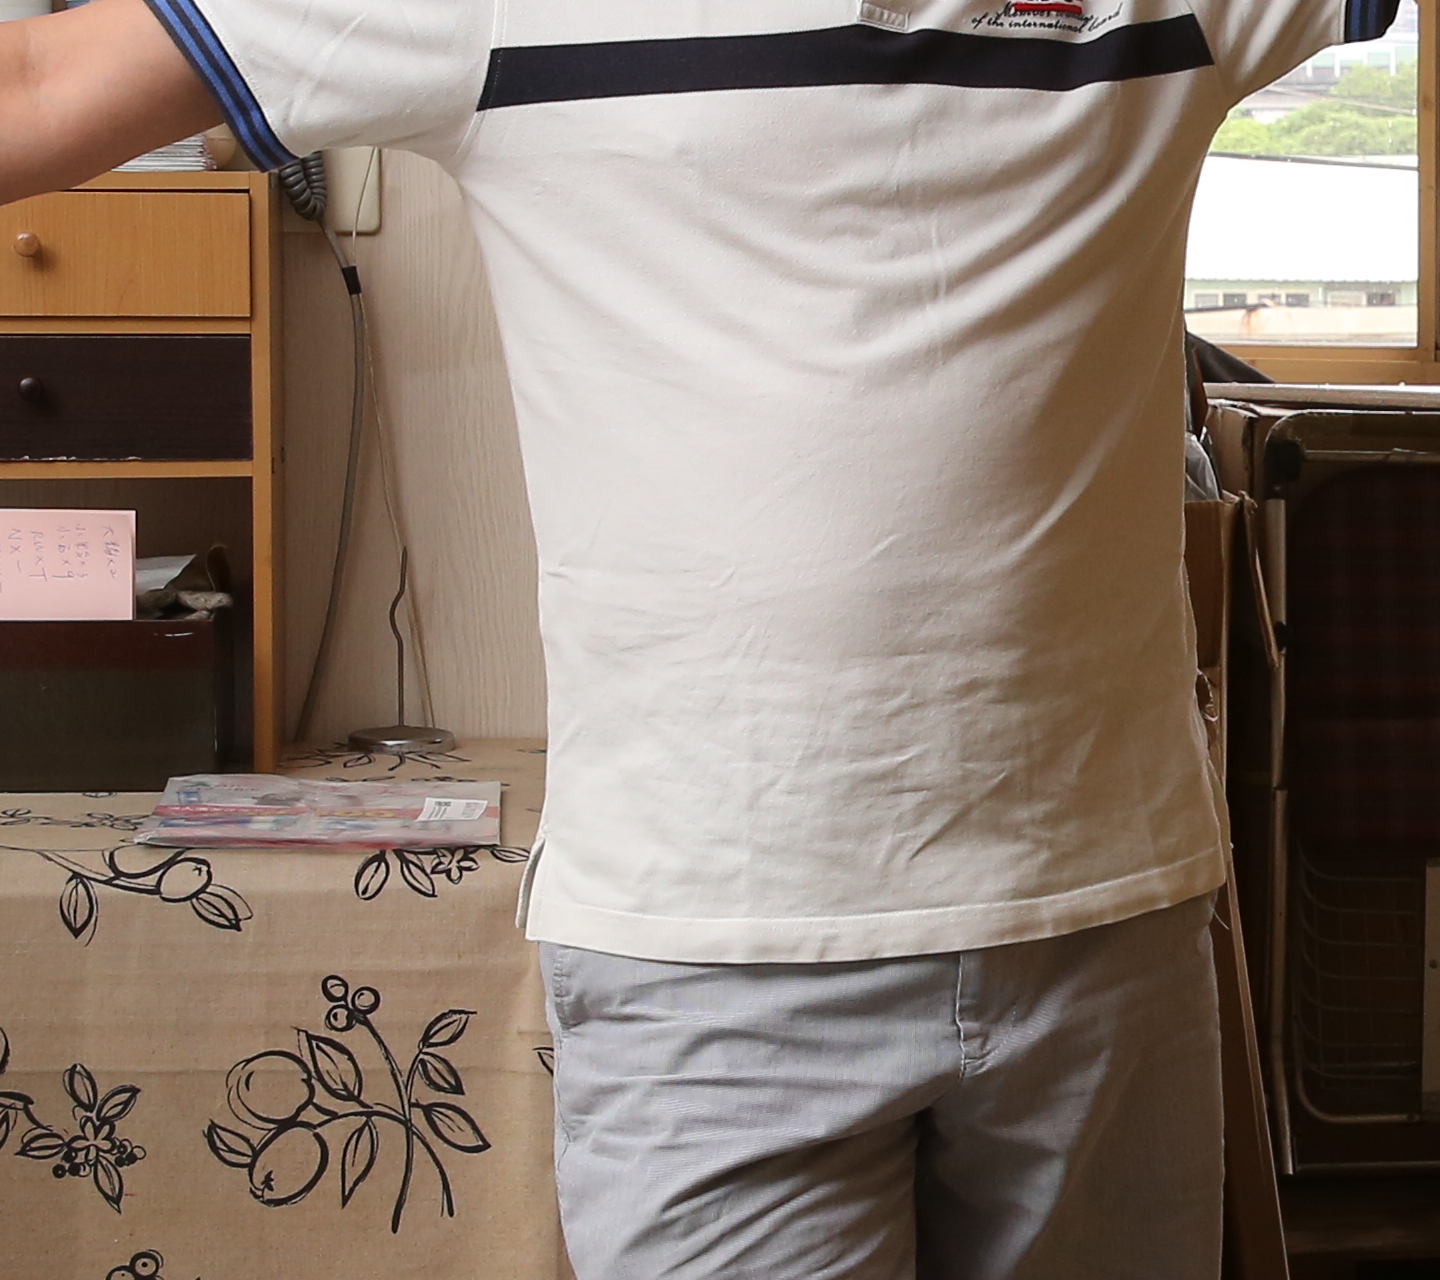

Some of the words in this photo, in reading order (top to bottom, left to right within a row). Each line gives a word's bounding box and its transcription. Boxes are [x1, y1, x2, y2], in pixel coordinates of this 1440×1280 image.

[972, 16, 984, 29] of
[987, 17, 1004, 28] the
[1009, 19, 1086, 33] international
